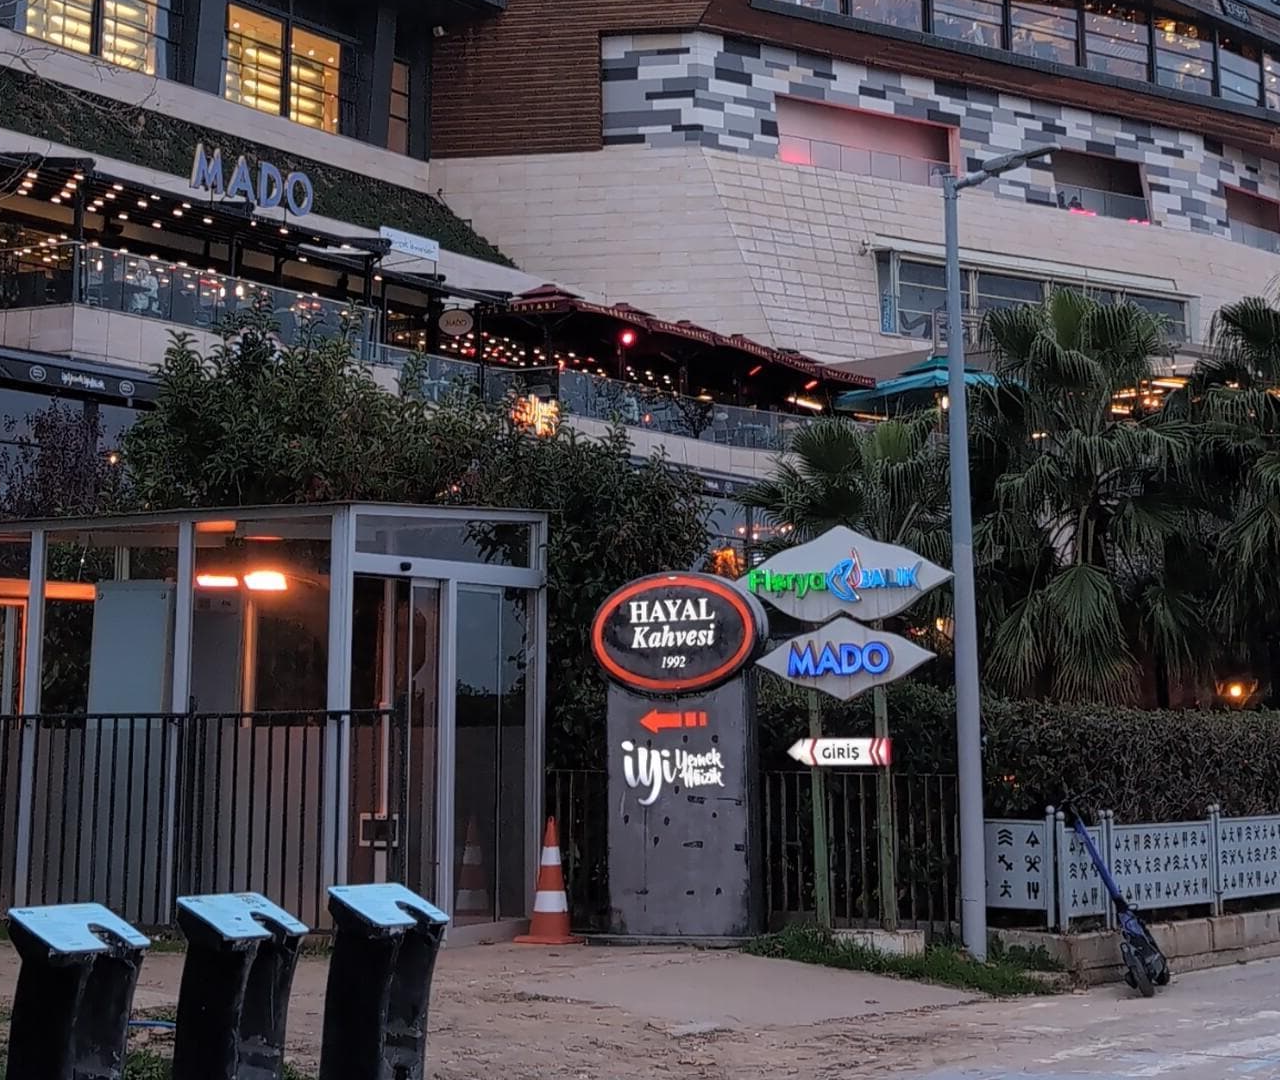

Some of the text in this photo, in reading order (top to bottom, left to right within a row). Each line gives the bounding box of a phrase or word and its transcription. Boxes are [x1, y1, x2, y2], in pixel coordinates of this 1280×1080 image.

[190, 142, 313, 217] MADO
[861, 561, 923, 590] BALIK
[629, 598, 716, 623] HAYAL
[631, 623, 716, 648] Kahvesi
[661, 655, 686, 669] 1992
[787, 640, 894, 678] MADO
[822, 743, 860, 761] GİRİŞ
[621, 740, 677, 806] iyi
